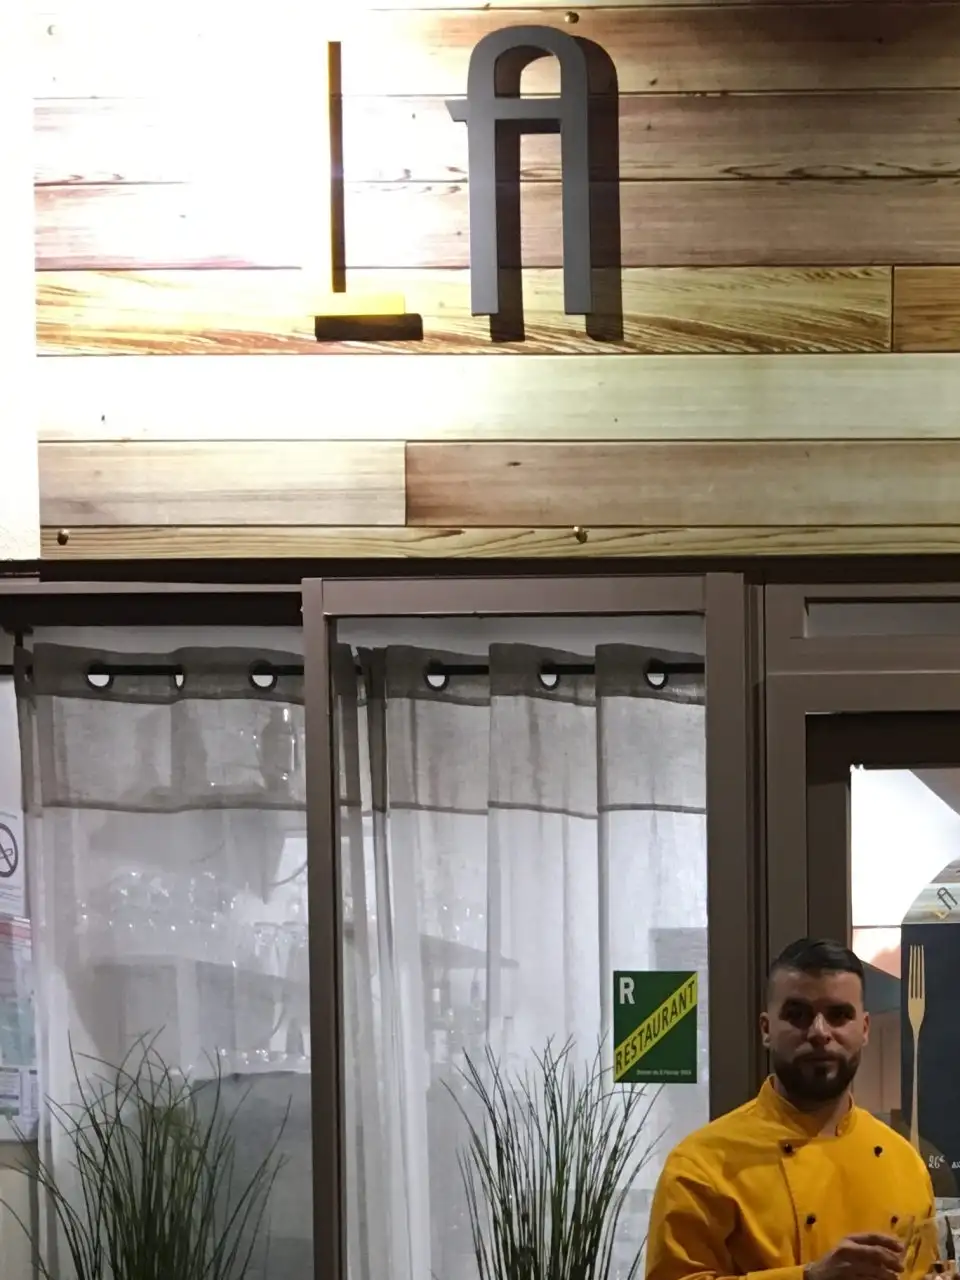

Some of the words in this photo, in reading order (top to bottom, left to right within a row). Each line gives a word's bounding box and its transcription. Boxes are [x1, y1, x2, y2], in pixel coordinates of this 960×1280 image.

[313, 25, 592, 316] LA
[615, 980, 695, 1073] RESTAURANT
[619, 977, 636, 1005] R
